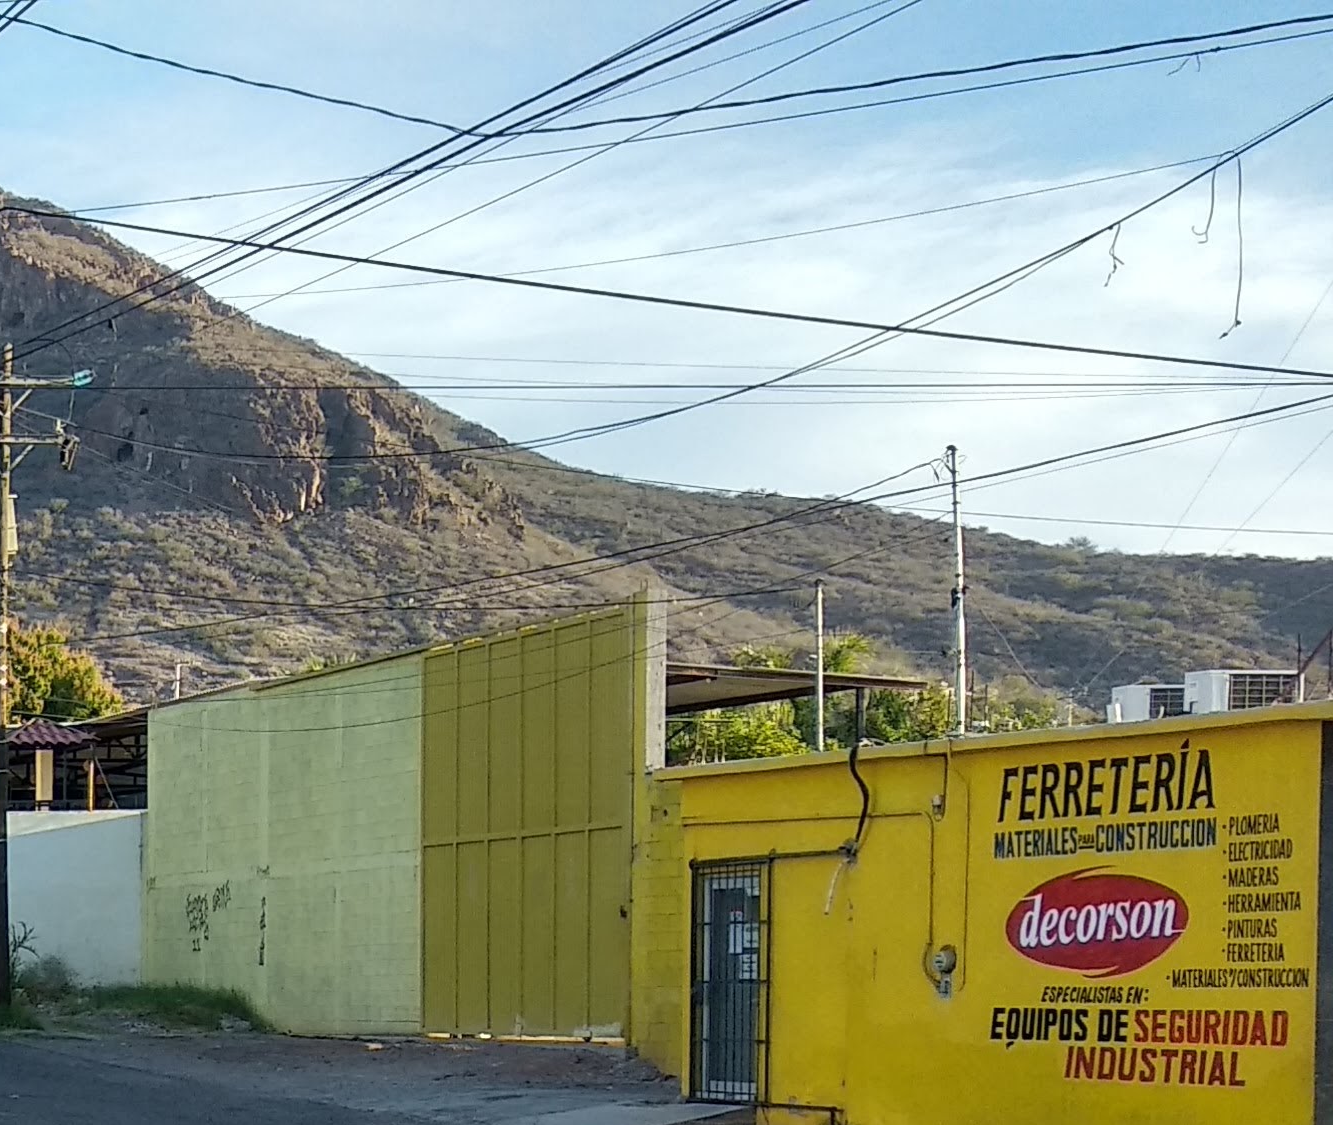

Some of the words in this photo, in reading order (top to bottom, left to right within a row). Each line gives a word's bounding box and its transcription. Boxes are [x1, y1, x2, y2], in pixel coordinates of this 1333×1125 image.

[997, 738, 1217, 823] FERRETERÍA
[1228, 812, 1280, 837] PLOMERIA
[994, 826, 1079, 860] MATERIALES
[1095, 816, 1218, 854] CONSTRUCCION
[1227, 837, 1294, 863] ELECTRICIDAD
[1227, 865, 1280, 888] MADERAS
[1227, 891, 1302, 914] HERRAMIENTA
[1019, 893, 1185, 949] decorson
[1226, 917, 1278, 940] PINTURAS
[1226, 942, 1286, 963] FERRETERIA
[1171, 968, 1228, 988] MATERIALES
[1237, 967, 1310, 988] CONSTRUCCION
[1041, 986, 1124, 1004] ESPECIALISTAS
[1125, 986, 1150, 1005] EN:
[990, 1007, 1089, 1050] EQUIPOS
[1098, 1008, 1129, 1043] DE
[1134, 1008, 1290, 1047] SEGURIDAD
[1064, 1046, 1246, 1087] INDUSTRIAL
